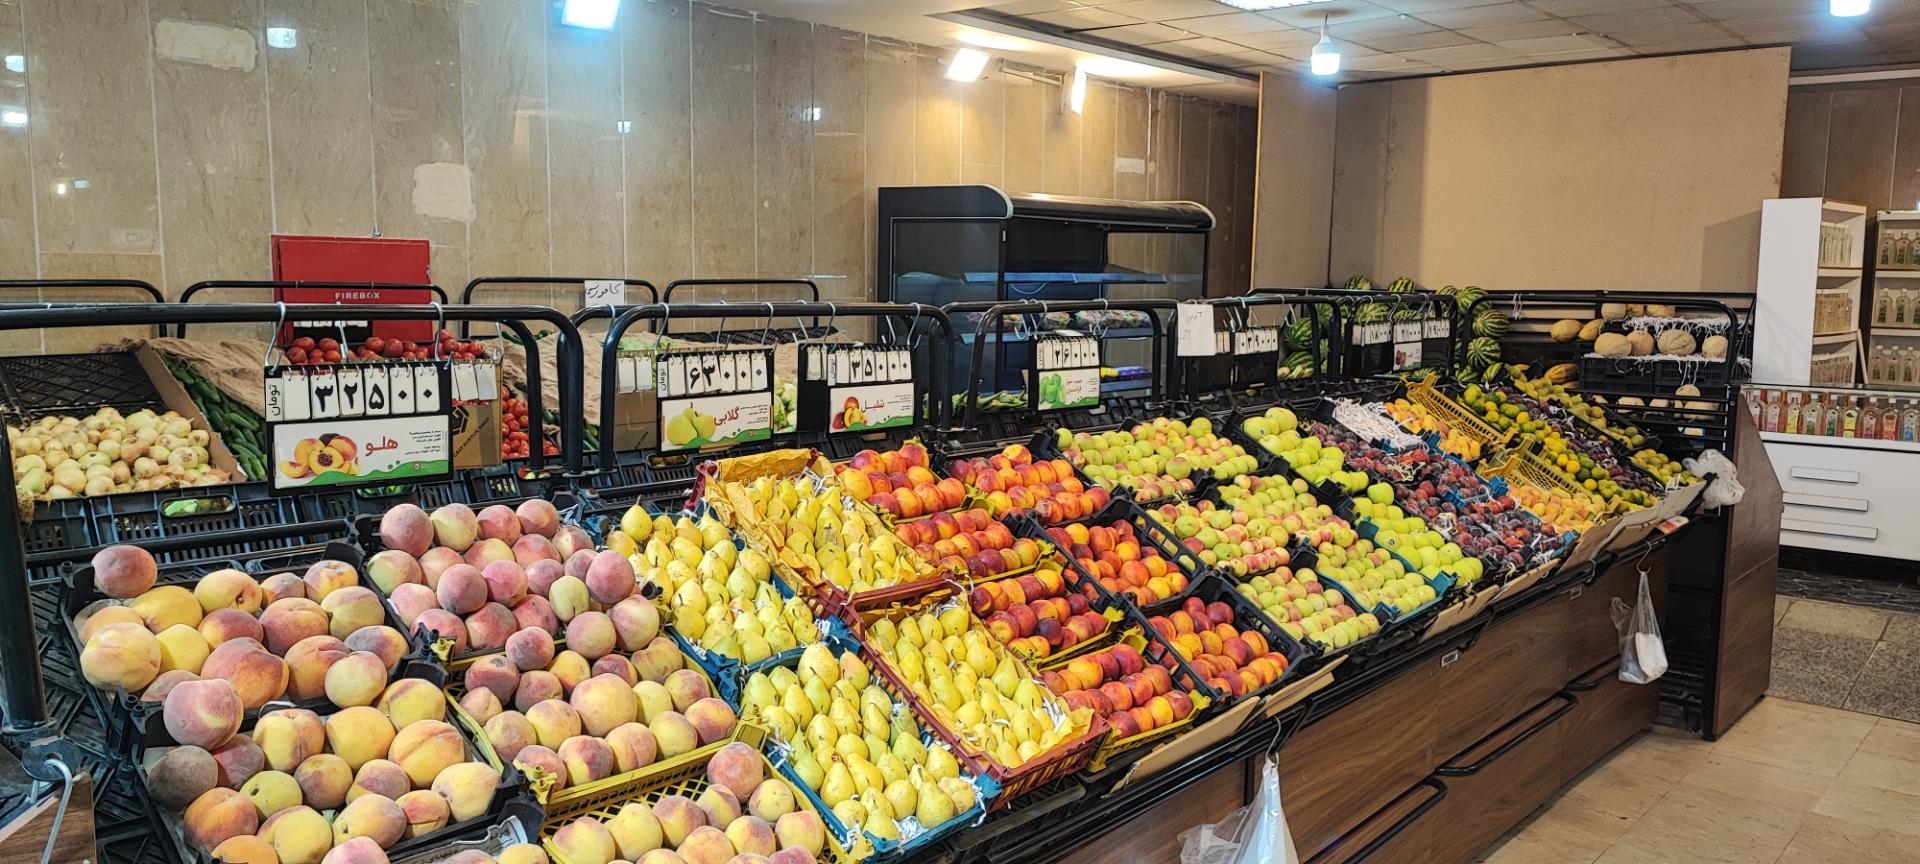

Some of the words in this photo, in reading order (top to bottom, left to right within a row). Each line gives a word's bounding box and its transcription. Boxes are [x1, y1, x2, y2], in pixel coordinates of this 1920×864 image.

[335, 291, 380, 300] FIREBOX
[1055, 348, 1096, 365] ۲۶۰۰۰
[689, 364, 762, 390] ۶۳۰۰۰
[851, 359, 908, 379] ۳۵۰۰۰
[268, 385, 281, 416] تومان
[314, 382, 433, 413] ۳۲۵۰۰
[861, 399, 885, 413] شلیل
[713, 405, 740, 426] گلابی
[365, 435, 398, 457] هلو
